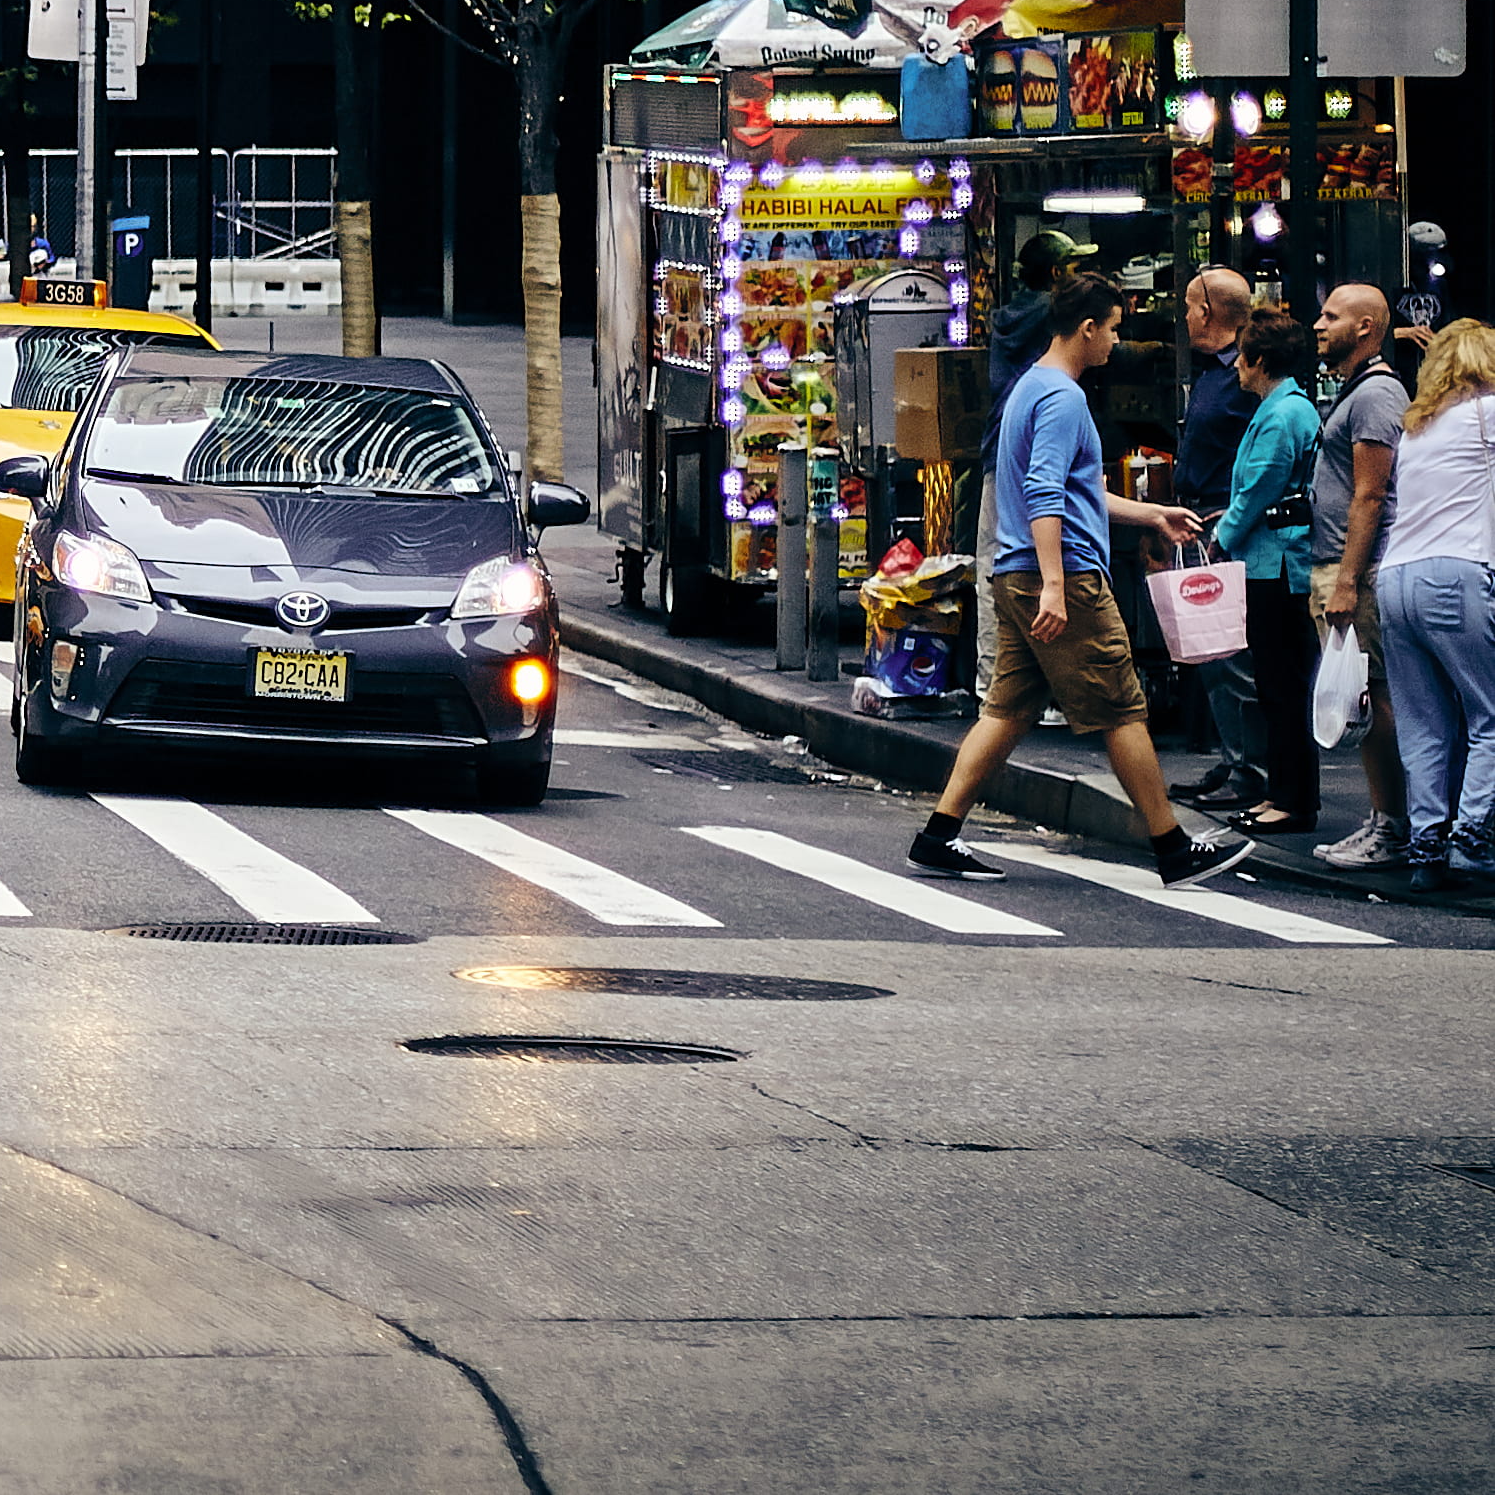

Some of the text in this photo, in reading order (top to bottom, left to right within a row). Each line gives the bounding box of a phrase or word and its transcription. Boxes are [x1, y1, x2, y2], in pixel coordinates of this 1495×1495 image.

[761, 44, 877, 66] Poland Spring
[741, 199, 812, 216] HABIBI
[819, 198, 890, 215] HALAL
[830, 221, 847, 229] TRY
[124, 233, 139, 255] P
[45, 284, 85, 304] 3G58
